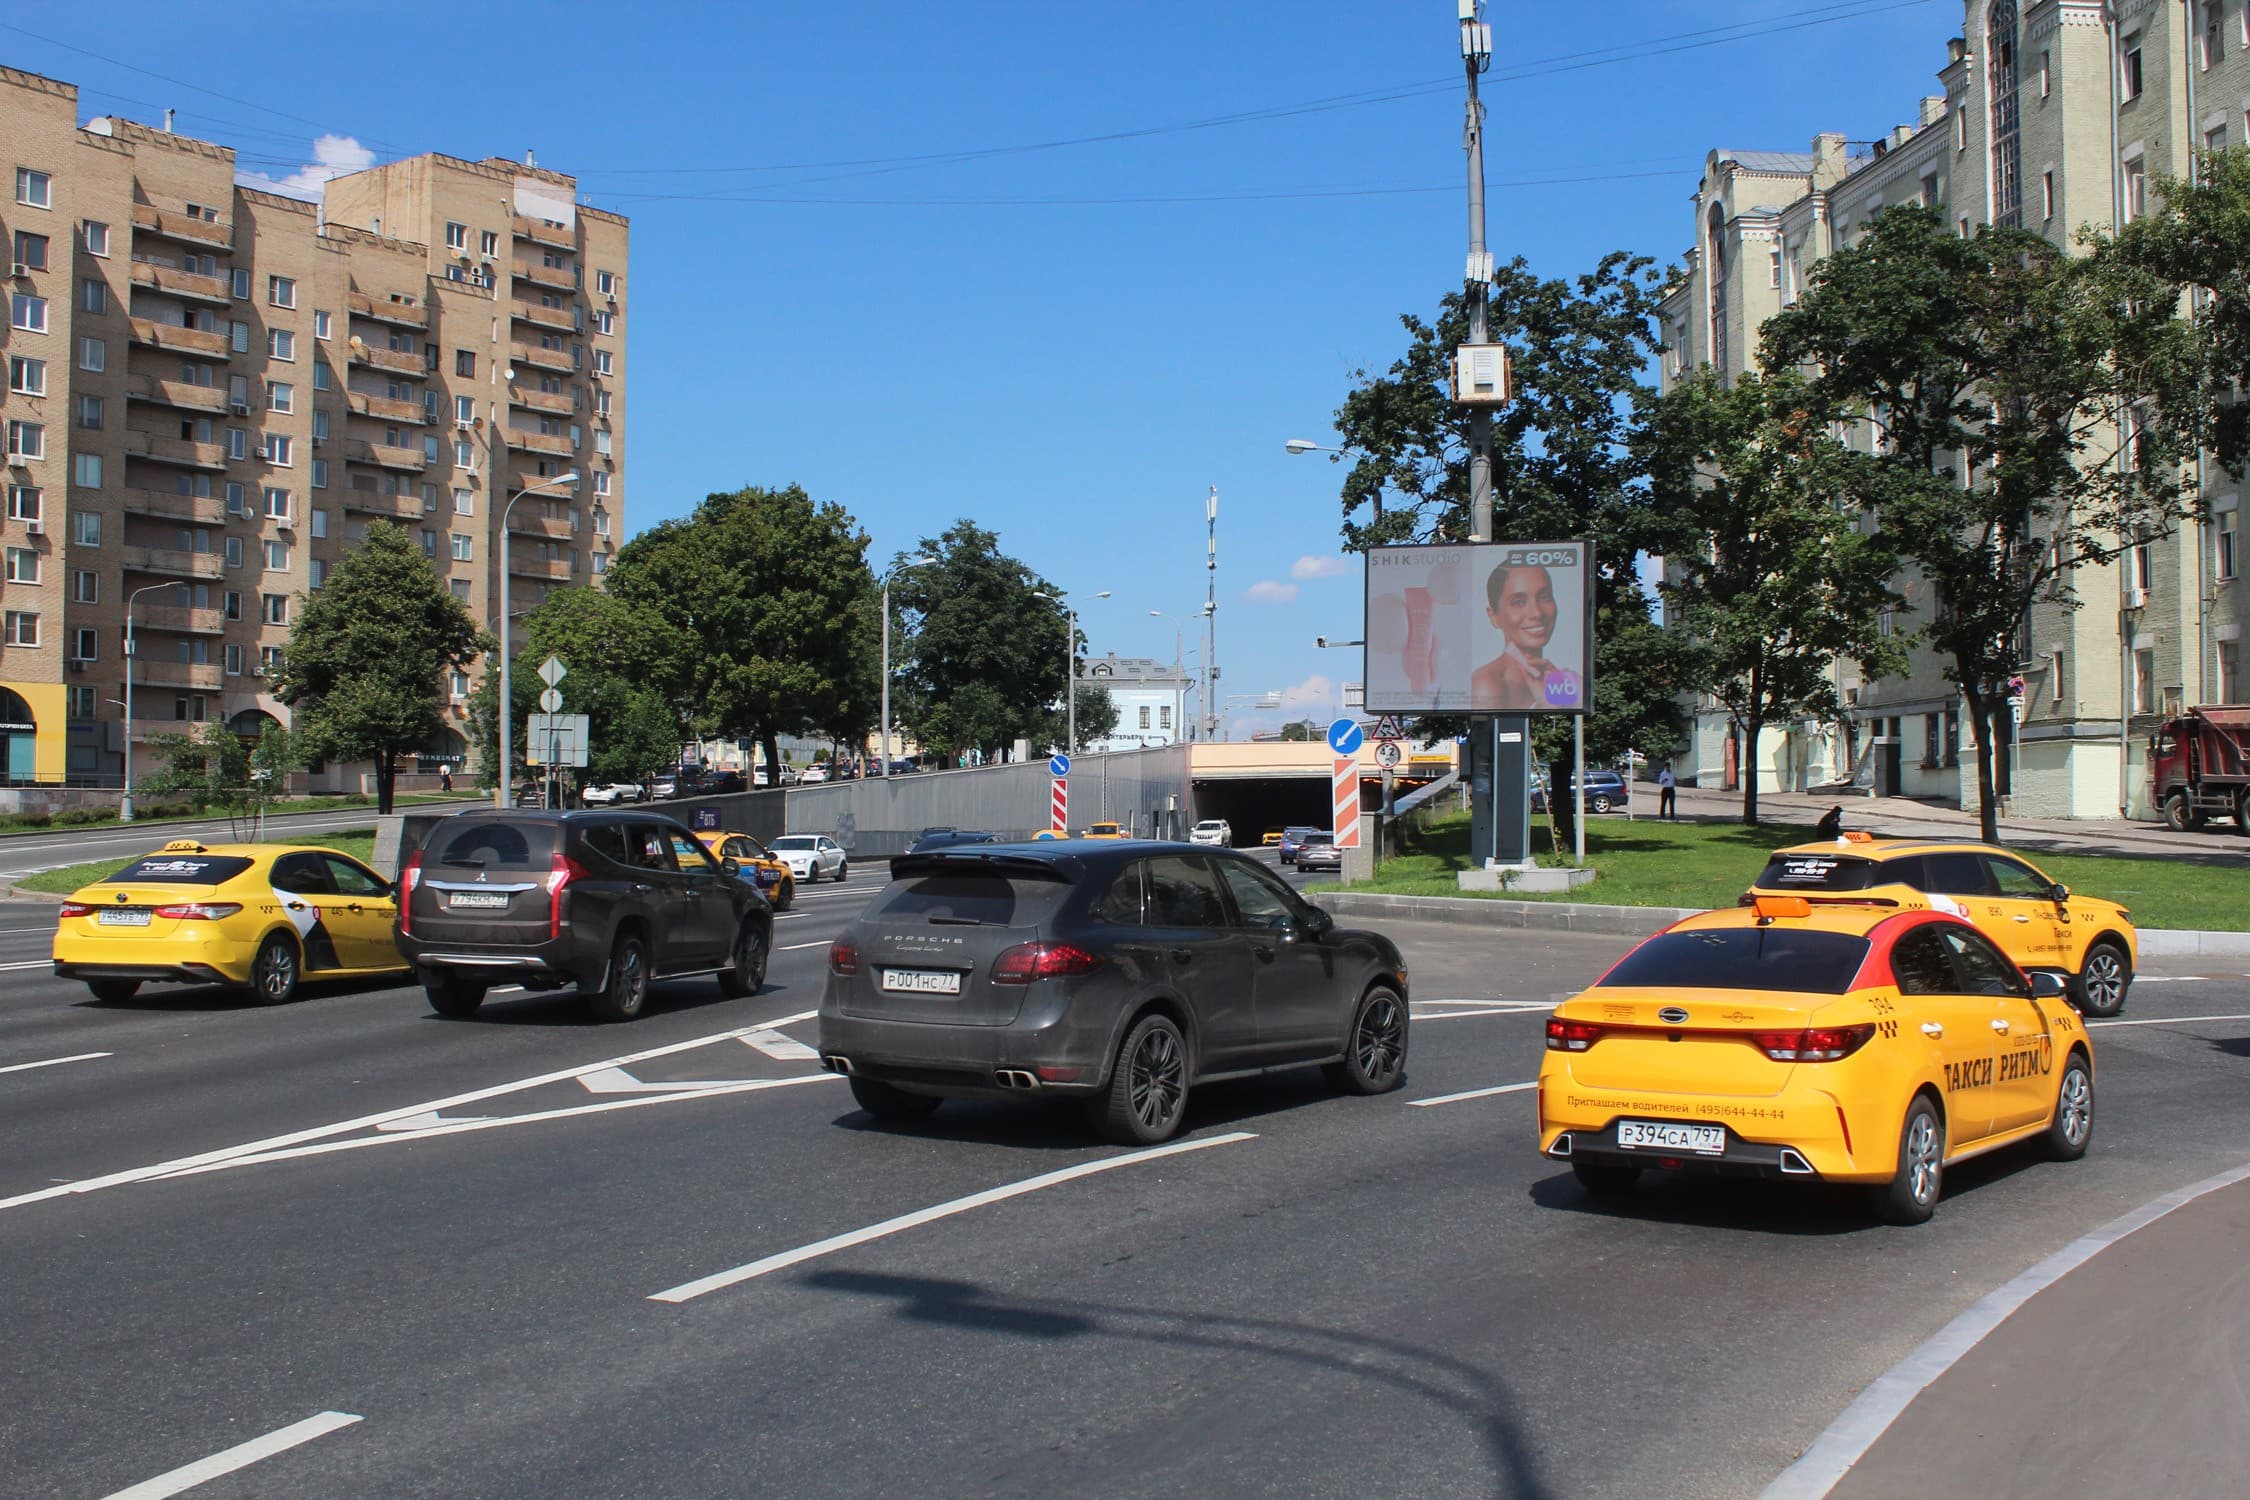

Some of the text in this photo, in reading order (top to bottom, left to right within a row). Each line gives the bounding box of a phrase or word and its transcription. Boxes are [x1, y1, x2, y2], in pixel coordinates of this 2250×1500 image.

[1372, 555, 1411, 566] SHIK
[703, 813, 716, 826] ВТБ
[884, 935, 964, 944] PORSCHE
[1869, 997, 1896, 1015] 394
[1944, 1057, 1994, 1092] ТАКСИ
[1567, 1096, 1785, 1120] Приглашаем водителей (495)644-44-44
[1623, 1124, 1722, 1146] Р394СА 797
